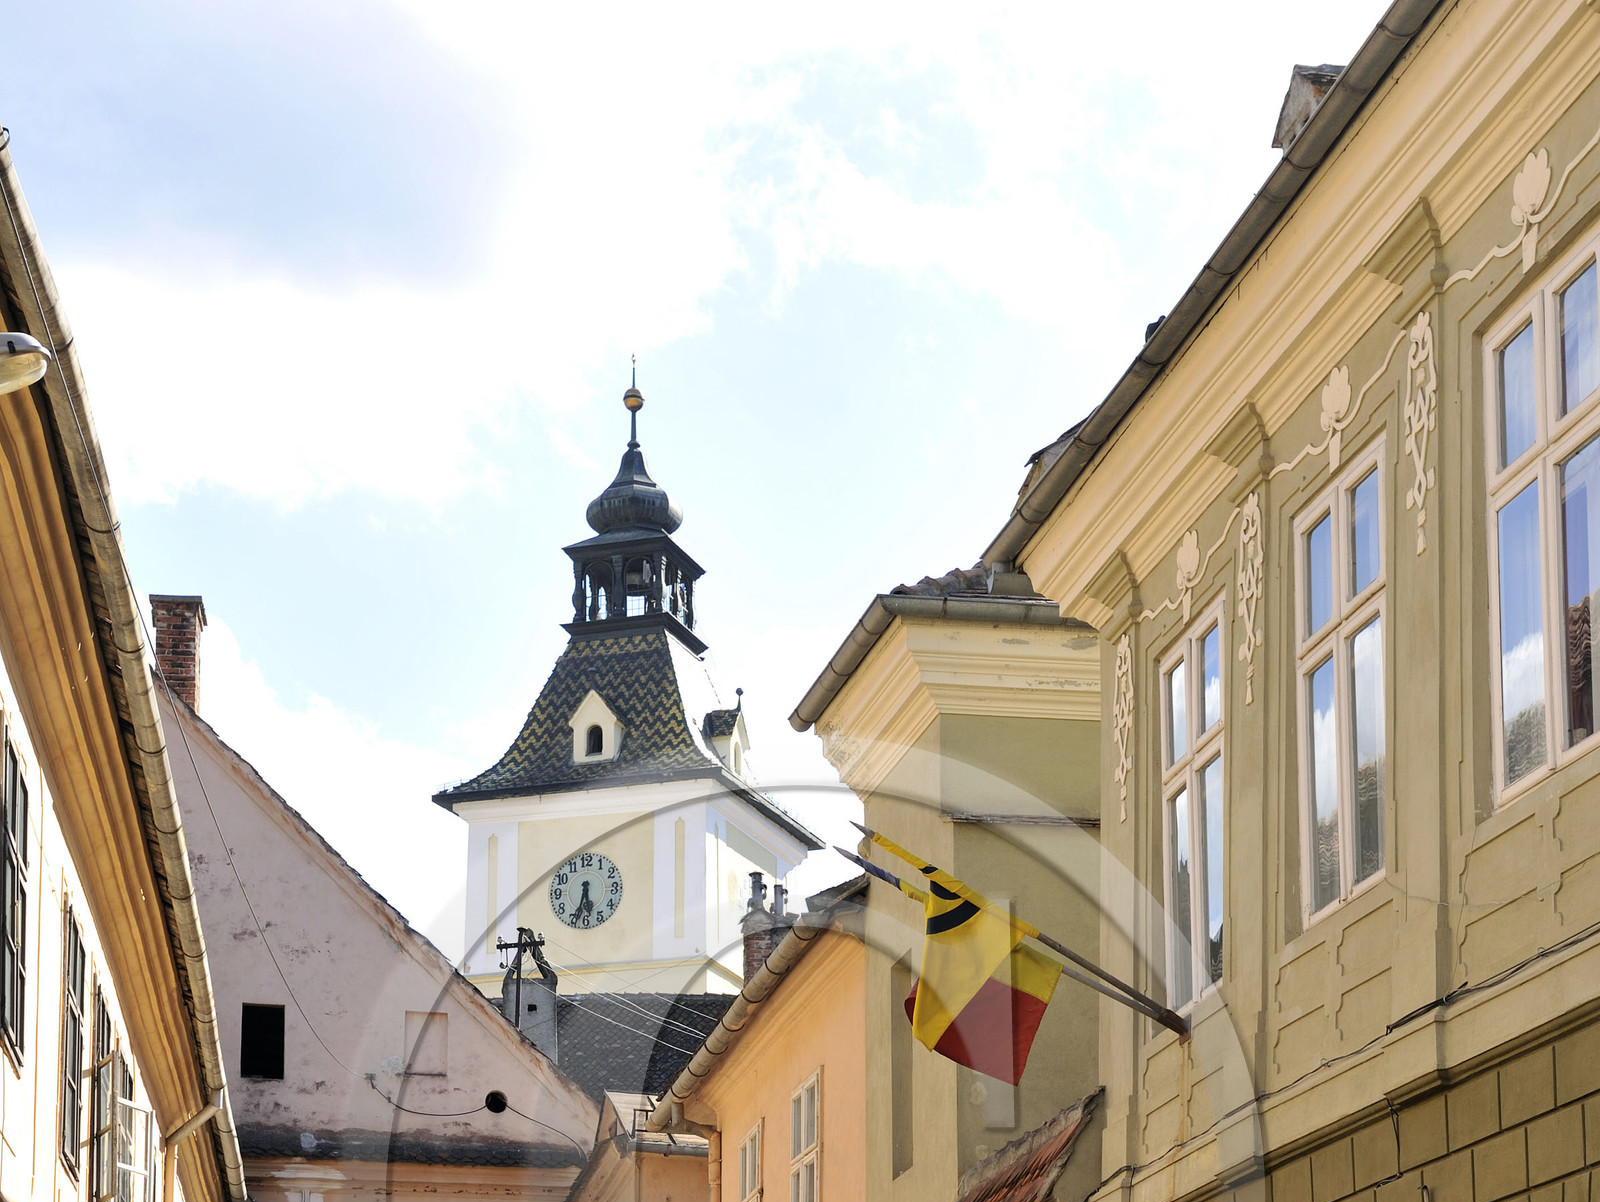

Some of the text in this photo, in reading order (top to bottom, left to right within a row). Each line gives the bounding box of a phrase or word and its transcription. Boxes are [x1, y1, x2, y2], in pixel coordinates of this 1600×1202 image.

[569, 861, 577, 873] 11
[580, 855, 593, 868] 12
[598, 858, 603, 870] 1
[557, 873, 568, 885] 10
[608, 867, 615, 879] 2
[554, 888, 562, 900] 9
[611, 882, 618, 895] 3
[558, 903, 565, 914] 8
[607, 899, 614, 909] 4
[582, 915, 590, 926] 6
[596, 911, 603, 922] 5
